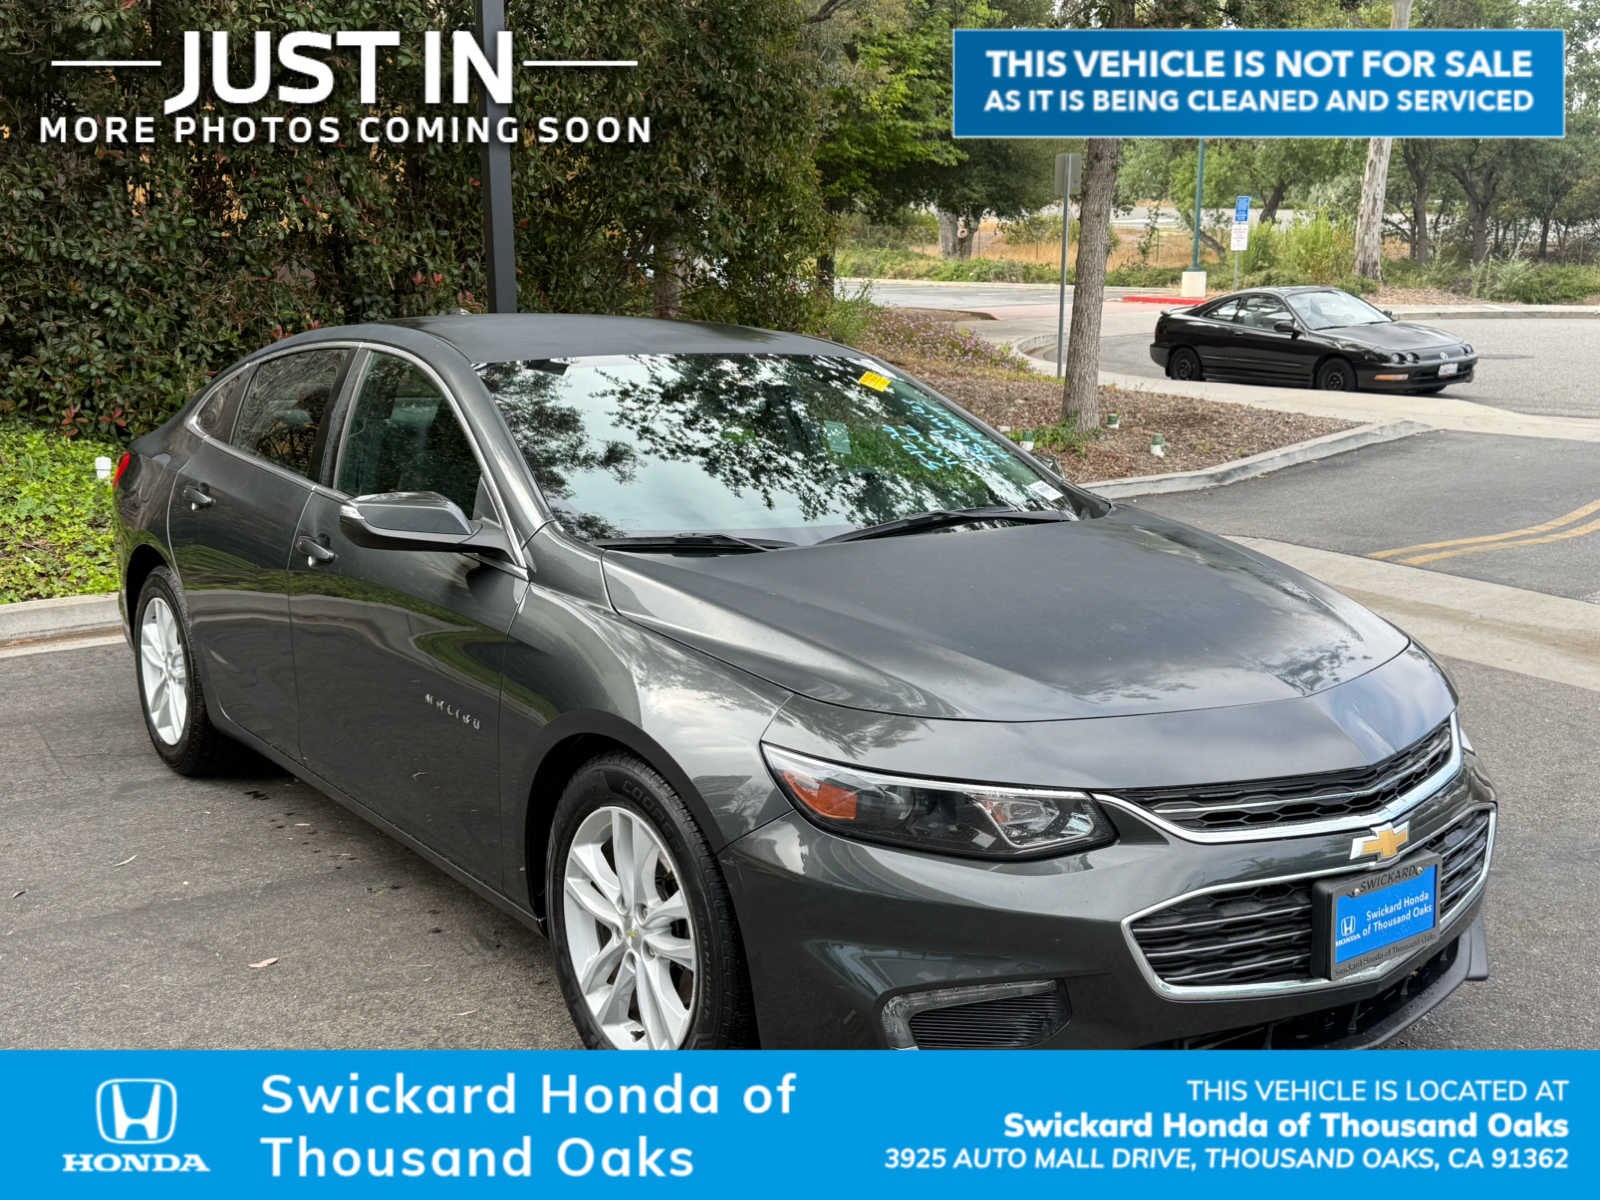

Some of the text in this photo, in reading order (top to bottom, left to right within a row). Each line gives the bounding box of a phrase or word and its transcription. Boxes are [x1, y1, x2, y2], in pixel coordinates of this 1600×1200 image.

[1360, 864, 1417, 893] SWICKARD
[1362, 904, 1433, 936] of Thousand Oaks
[1366, 891, 1430, 921] Swickard Honda
